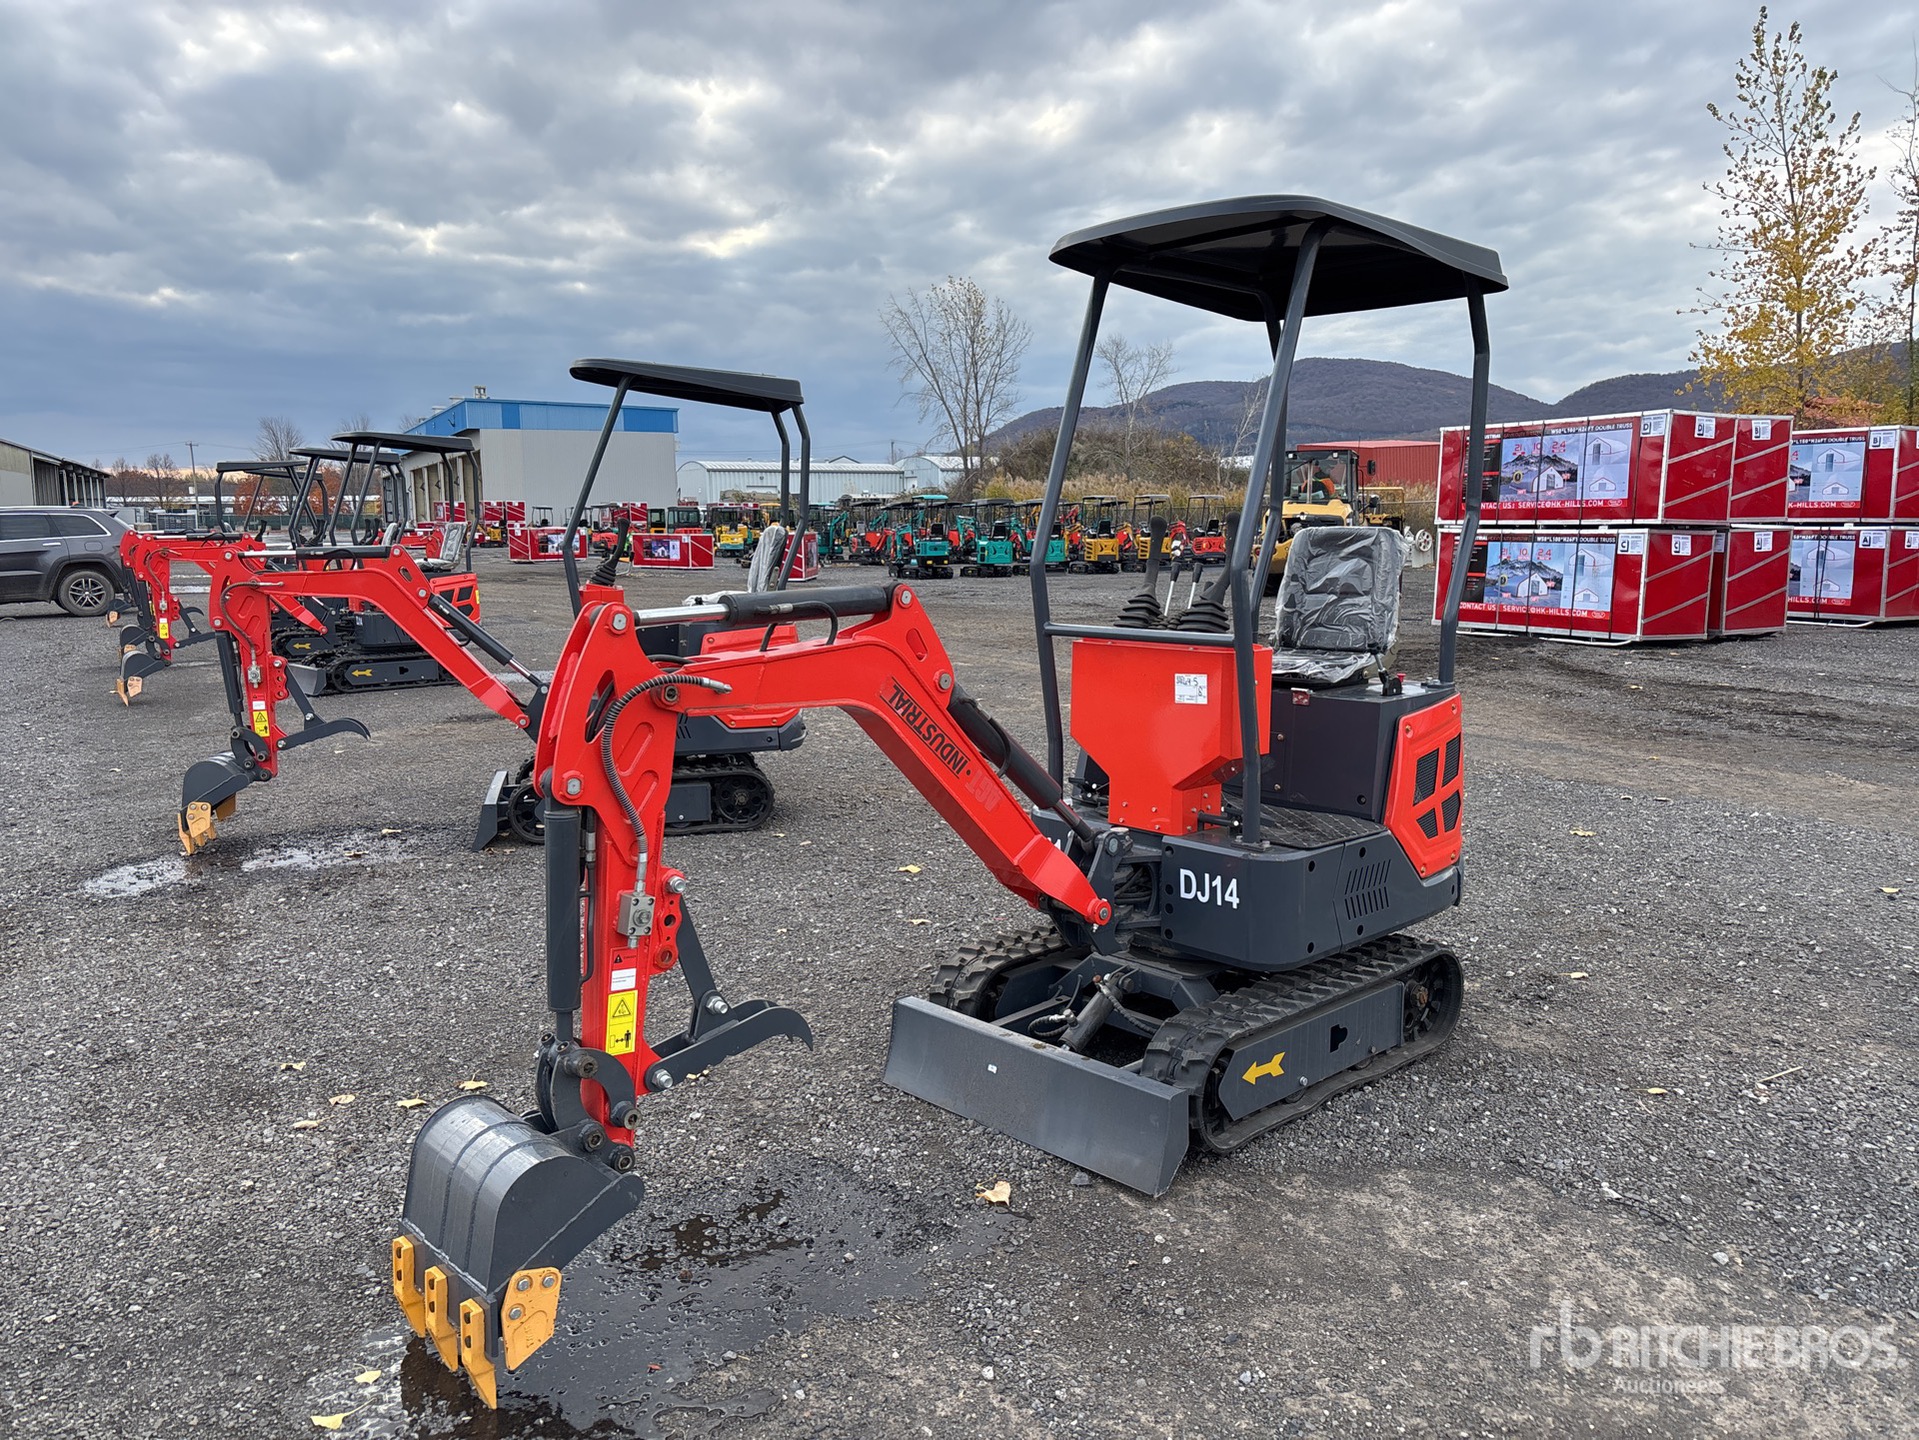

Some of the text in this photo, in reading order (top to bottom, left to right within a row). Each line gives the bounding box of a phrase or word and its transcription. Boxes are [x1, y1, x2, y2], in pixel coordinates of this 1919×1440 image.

[1502, 605, 1588, 617] SERVIC@HK-HILLS.COM
[888, 684, 968, 775] INDUSTRIAL
[1179, 868, 1240, 910] DJ14
